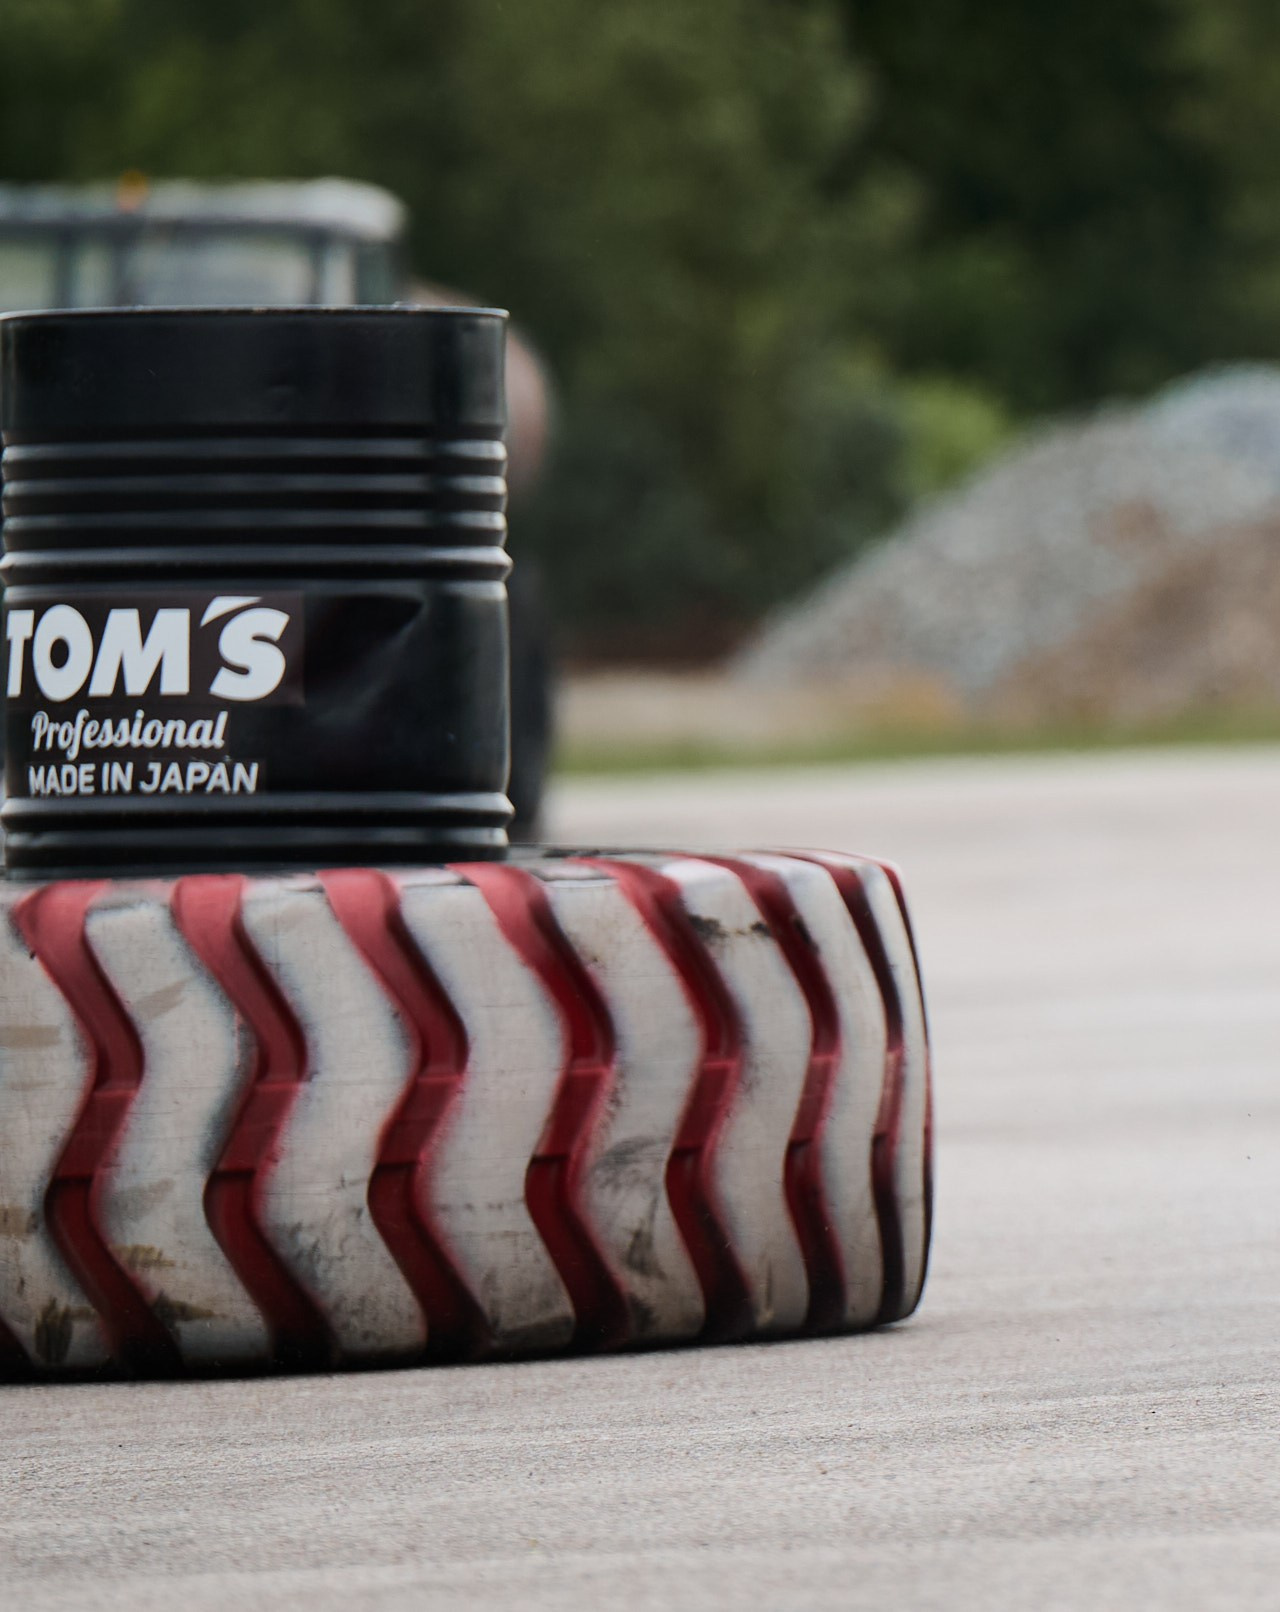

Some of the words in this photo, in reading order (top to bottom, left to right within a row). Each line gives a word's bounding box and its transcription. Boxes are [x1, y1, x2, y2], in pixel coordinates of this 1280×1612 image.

[31, 708, 229, 761] Professional
[28, 763, 96, 795] MADE
[101, 761, 134, 793] IN
[139, 761, 259, 794] JAPAN
